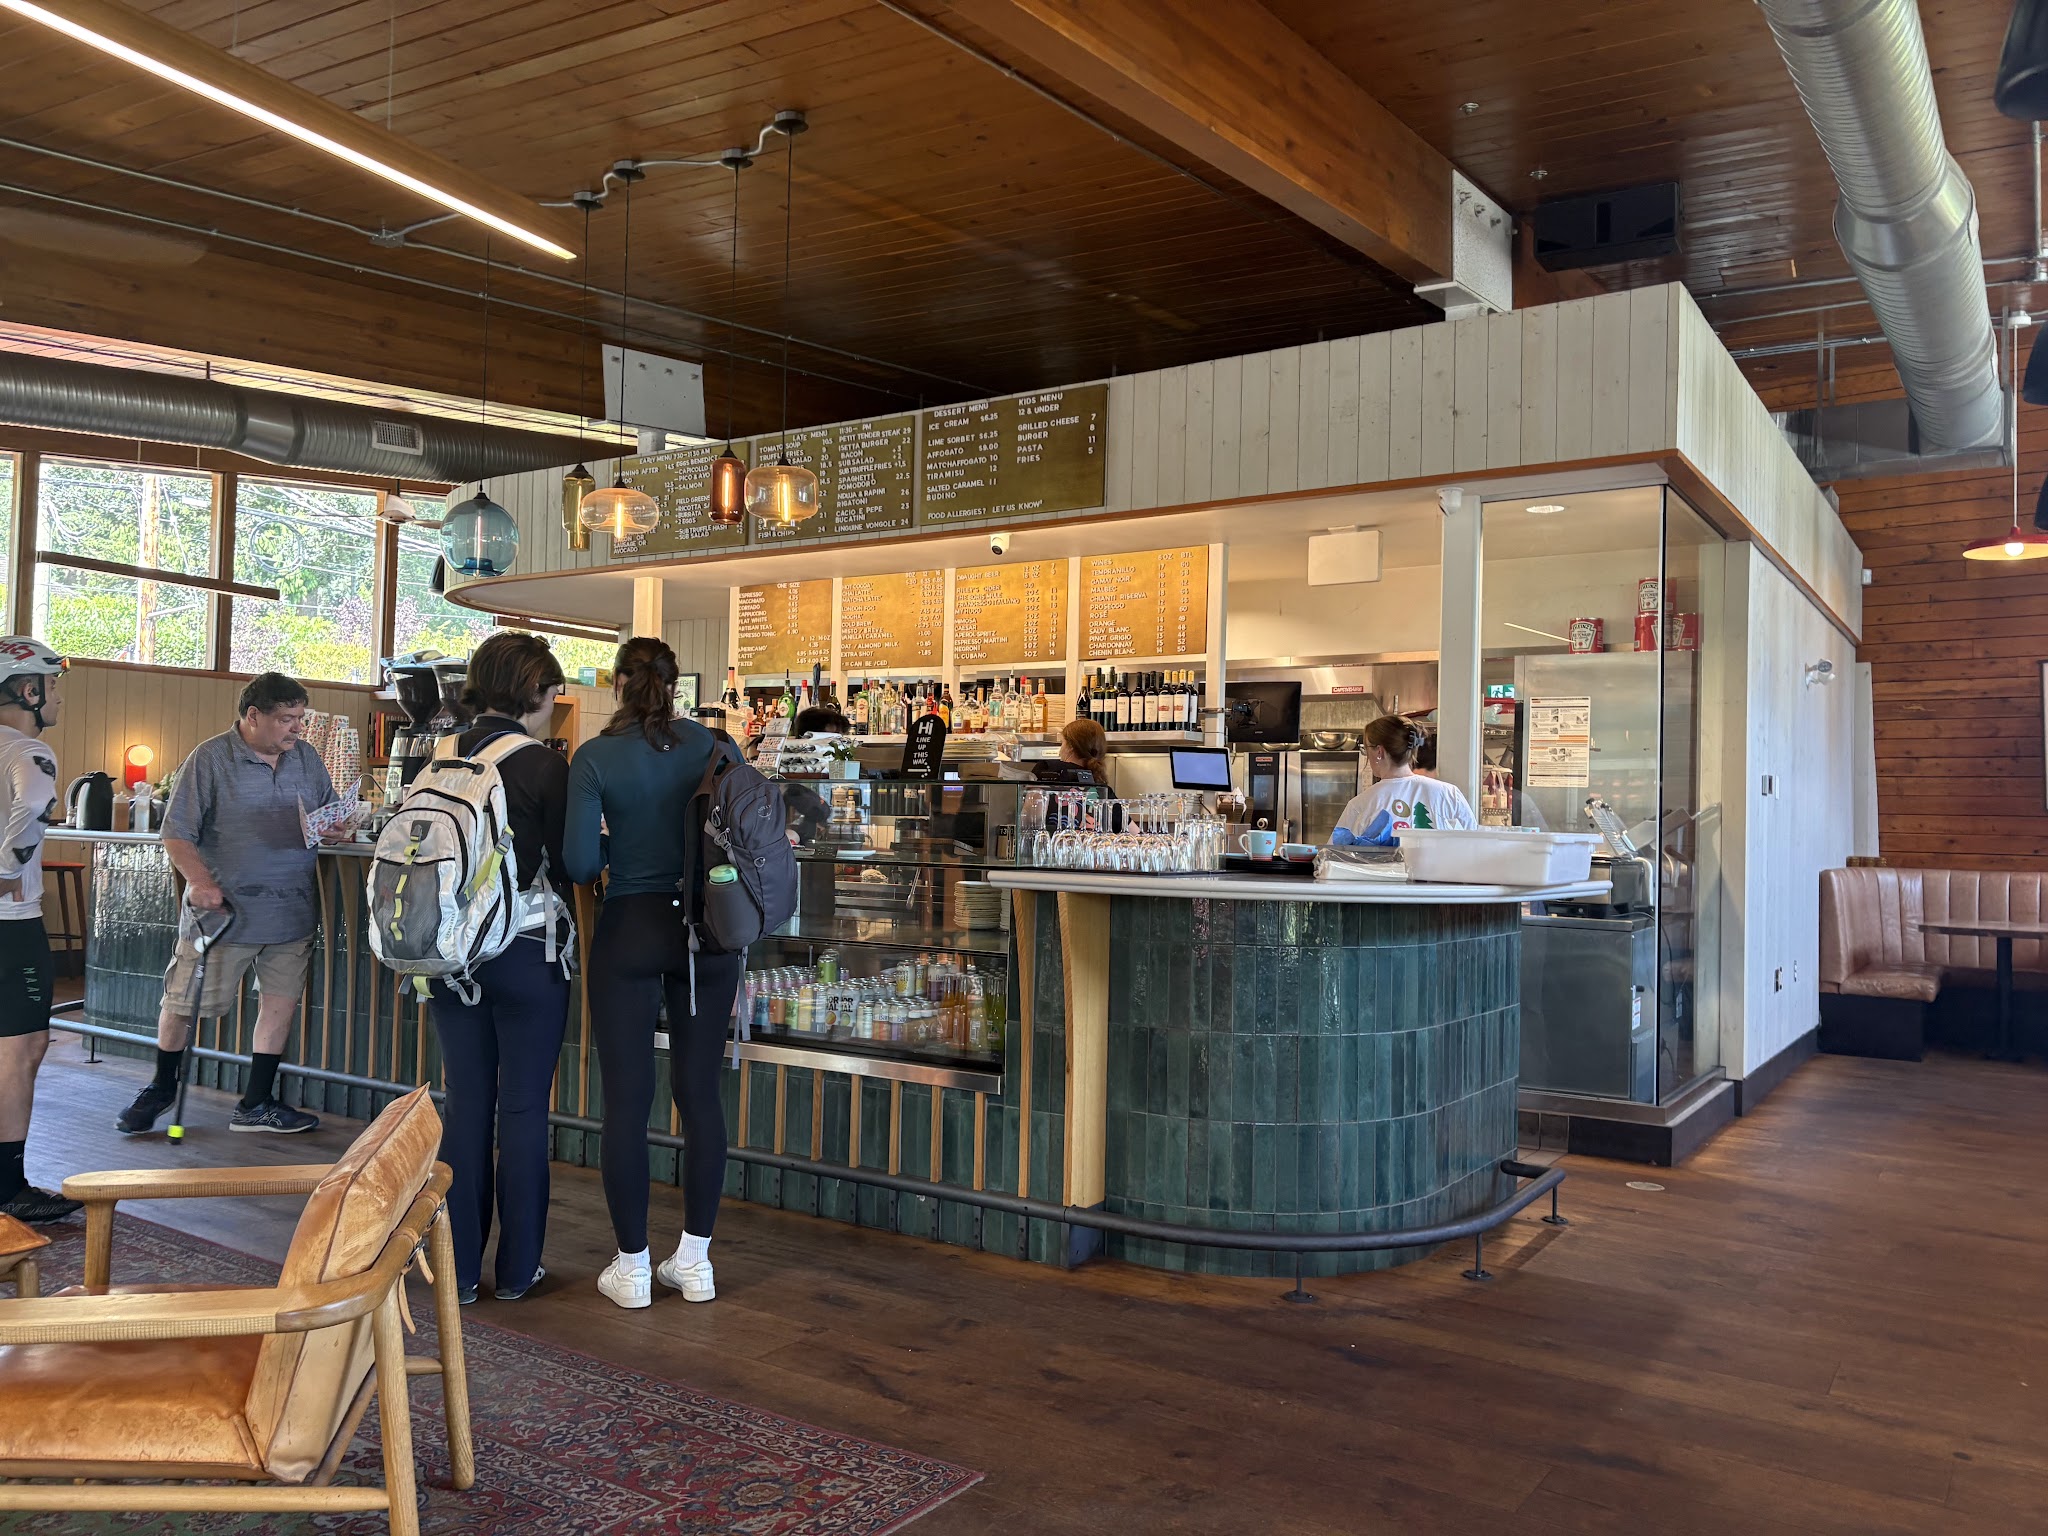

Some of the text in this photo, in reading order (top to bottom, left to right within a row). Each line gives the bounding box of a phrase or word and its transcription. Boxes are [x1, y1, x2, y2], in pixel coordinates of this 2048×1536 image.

[1019, 393, 1063, 406] KIDS MENU
[934, 403, 988, 418] DESSERT MENU
[1034, 404, 1059, 413] UNDER
[928, 413, 998, 431] ICE CREAM $6.25
[1018, 421, 1048, 431] GRILLED
[1050, 416, 1080, 427] CHEESE
[811, 430, 827, 439] MENU
[858, 432, 880, 440] TENDER
[882, 429, 901, 437] STEAK
[928, 431, 998, 447] LIME SORBET $6.25
[1018, 431, 1048, 442] BURGER
[759, 444, 783, 453] TOMATO
[838, 444, 860, 452] ISETTA
[861, 439, 888, 449] BURGER
[1017, 444, 1043, 453] PASTA
[841, 451, 863, 459] BACON
[927, 443, 998, 459] AFFOGATO $9.00
[657, 454, 672, 462] MENU
[691, 455, 718, 464] BENEDICT
[852, 457, 874, 465] SALAD
[1017, 454, 1040, 463] FRIES
[927, 457, 987, 470] MATCHAFFOGATO
[614, 469, 639, 478] MRNING
[849, 465, 870, 474] TRUFFLE
[839, 474, 874, 483] SPAGHETTI
[927, 470, 964, 480] TIRAMISU
[838, 480, 876, 490] POMODORO
[927, 484, 950, 493] SALTED
[953, 479, 984, 490] CARAMEL
[864, 488, 886, 497] RAPINI
[927, 492, 956, 501] BUDINO
[837, 498, 868, 508] RIGATONI
[836, 509, 855, 517] CACIO
[947, 508, 986, 518] ALLERGIES?
[836, 515, 865, 523] BUCATINI
[834, 524, 862, 533] LINGUINE
[866, 520, 896, 529] VONGOLE
[1092, 559, 1113, 567] WINES
[1092, 567, 1135, 576] TEMPRANILLO
[1120, 592, 1147, 601] RISERVA
[1089, 641, 1133, 649] CHARDONNAY
[918, 719, 934, 735] Hi
[23, 967, 41, 1001] MAAP
